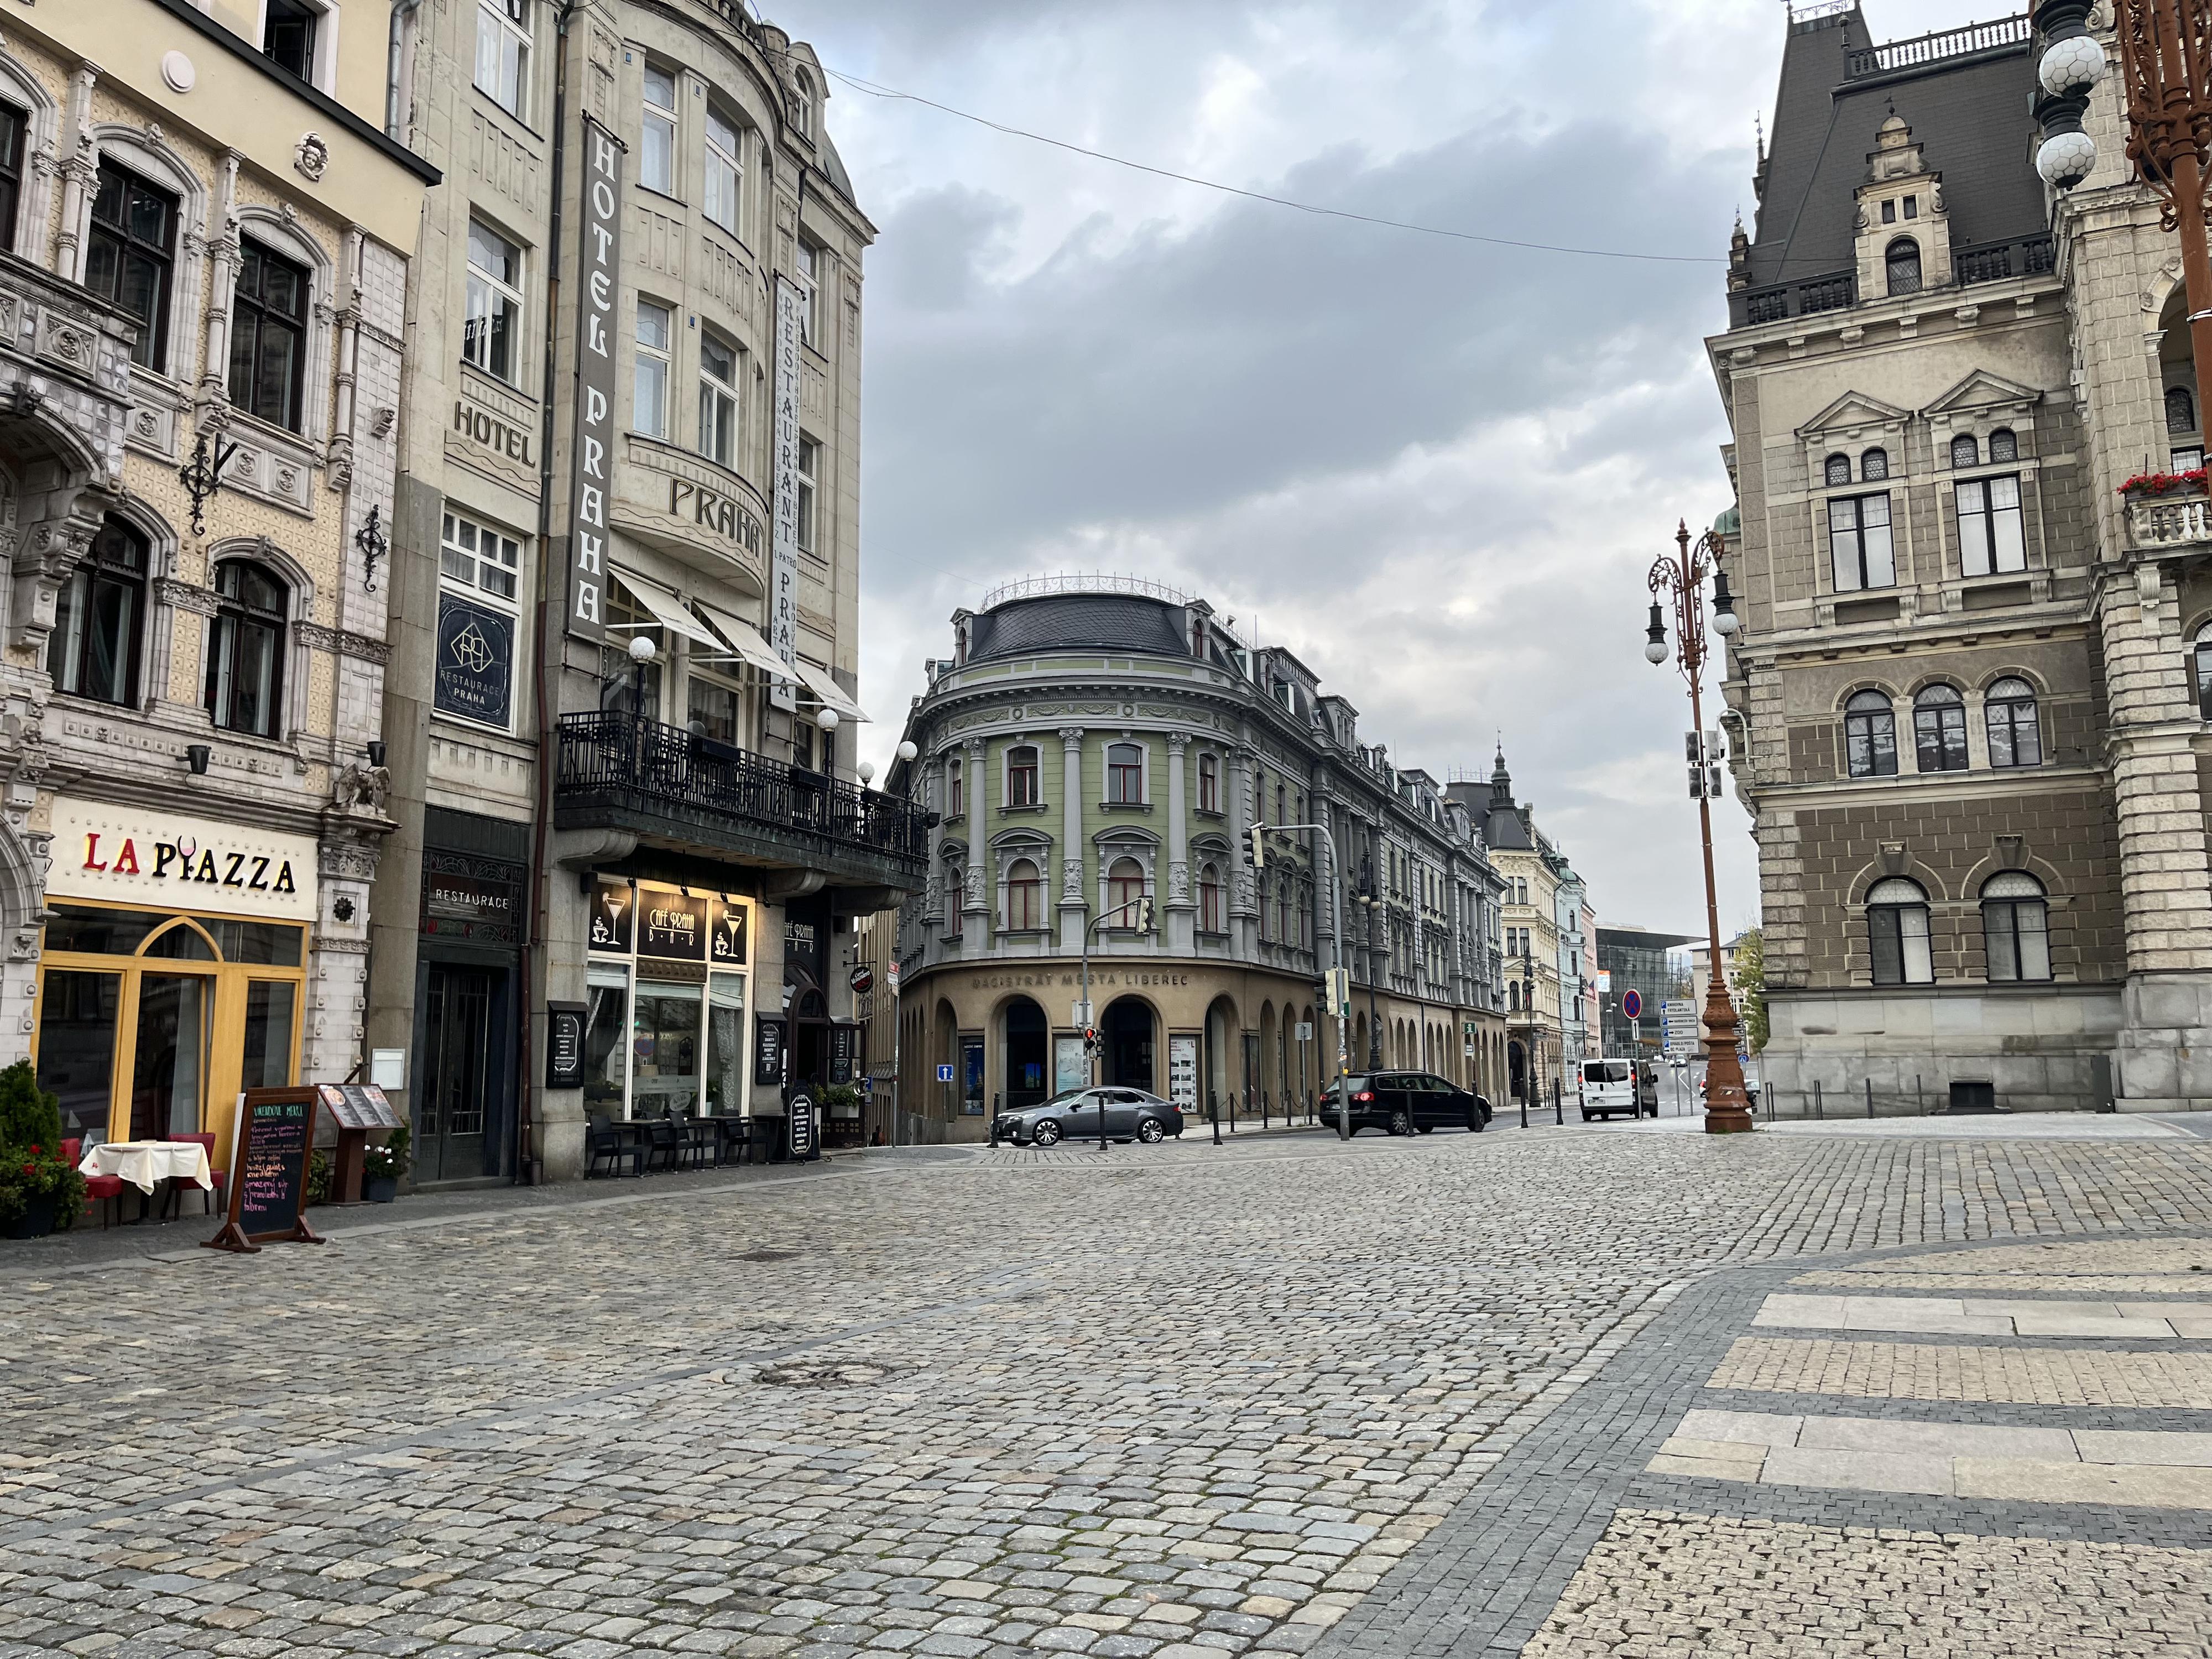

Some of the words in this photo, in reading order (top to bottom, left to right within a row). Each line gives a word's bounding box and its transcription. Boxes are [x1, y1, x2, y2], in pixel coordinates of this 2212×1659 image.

[589, 131, 616, 358] HOTEL
[781, 296, 795, 544] RESTAURANT
[455, 401, 536, 468] HOTEL
[576, 385, 608, 624] PRAHA
[670, 477, 764, 559] PRAHA
[779, 553, 797, 569] PATRO
[440, 670, 500, 696] RESTAURACE
[453, 687, 486, 705] PRAHA
[84, 833, 140, 875] LA
[153, 834, 296, 894] PIAZZA
[435, 889, 509, 910] RESTAURACE
[649, 907, 669, 927] CAFÉ
[670, 911, 695, 930] PRAHA
[784, 920, 793, 937] AFÉ
[794, 924, 813, 940] PRAHA
[1125, 974, 1188, 985] LIBEREC
